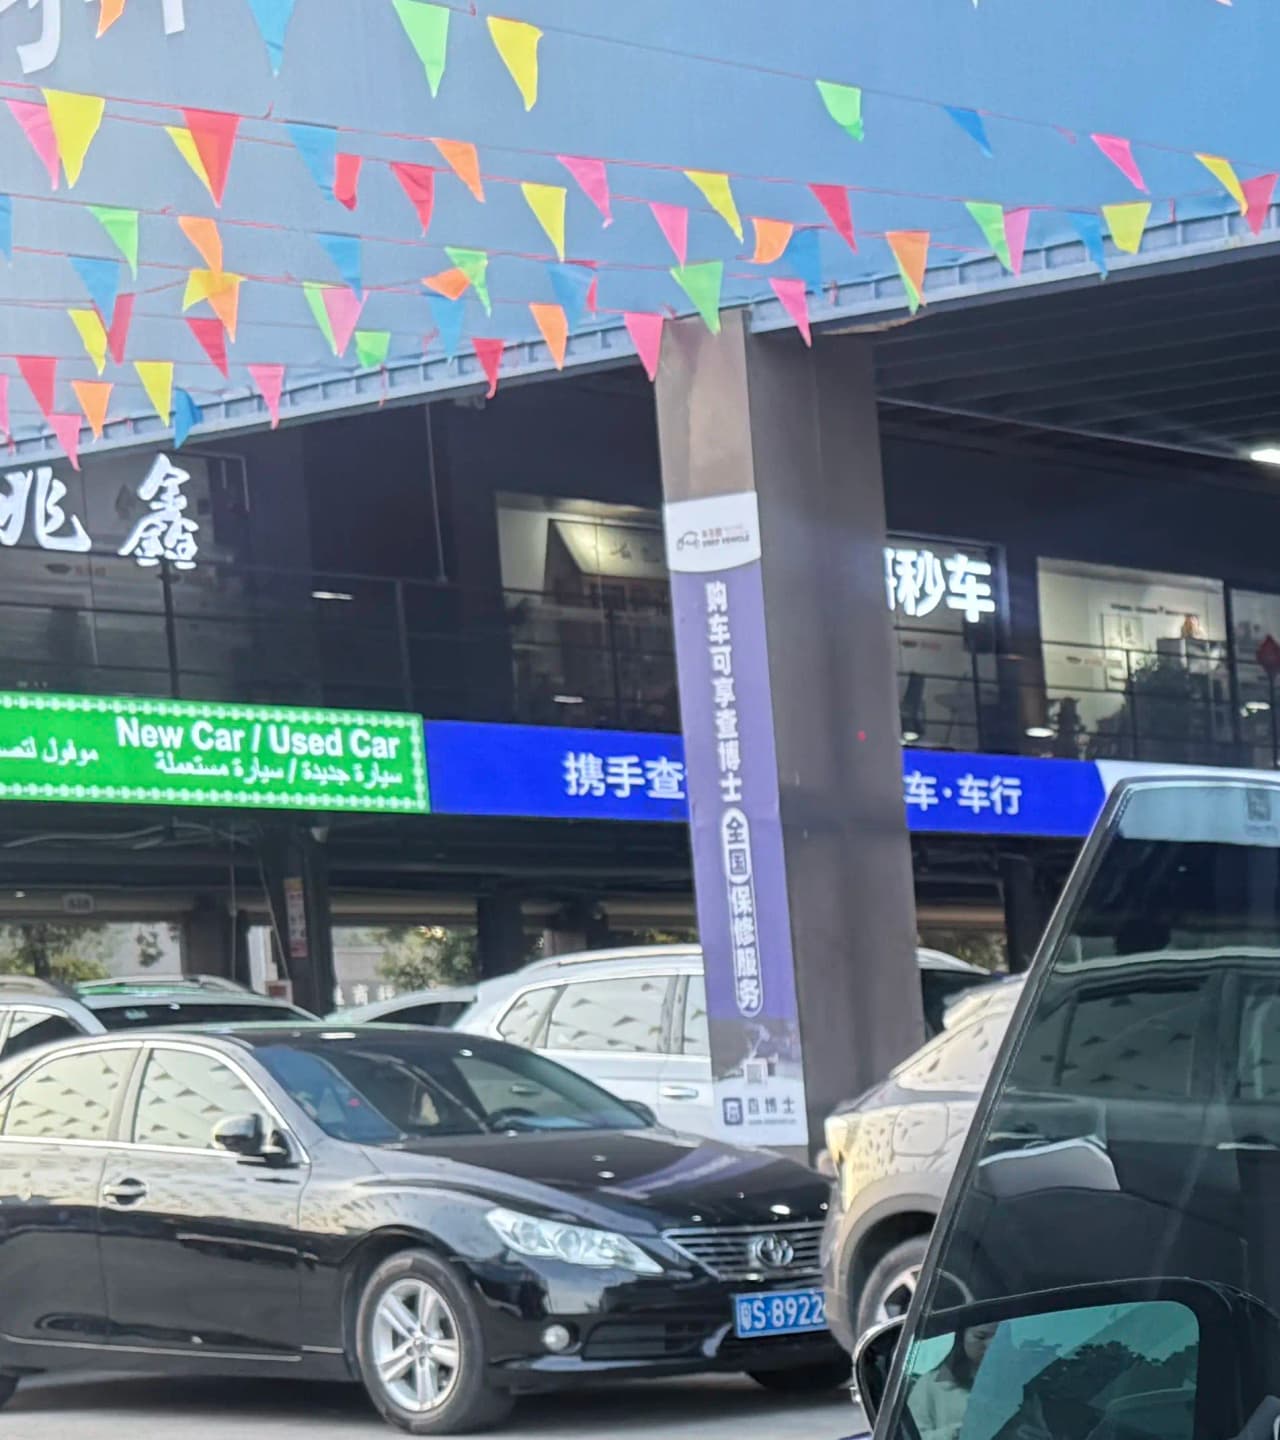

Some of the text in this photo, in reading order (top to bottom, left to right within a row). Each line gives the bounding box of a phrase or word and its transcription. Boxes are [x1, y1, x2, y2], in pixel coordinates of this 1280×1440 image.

[116, 716, 401, 759] New Car / Used Car
